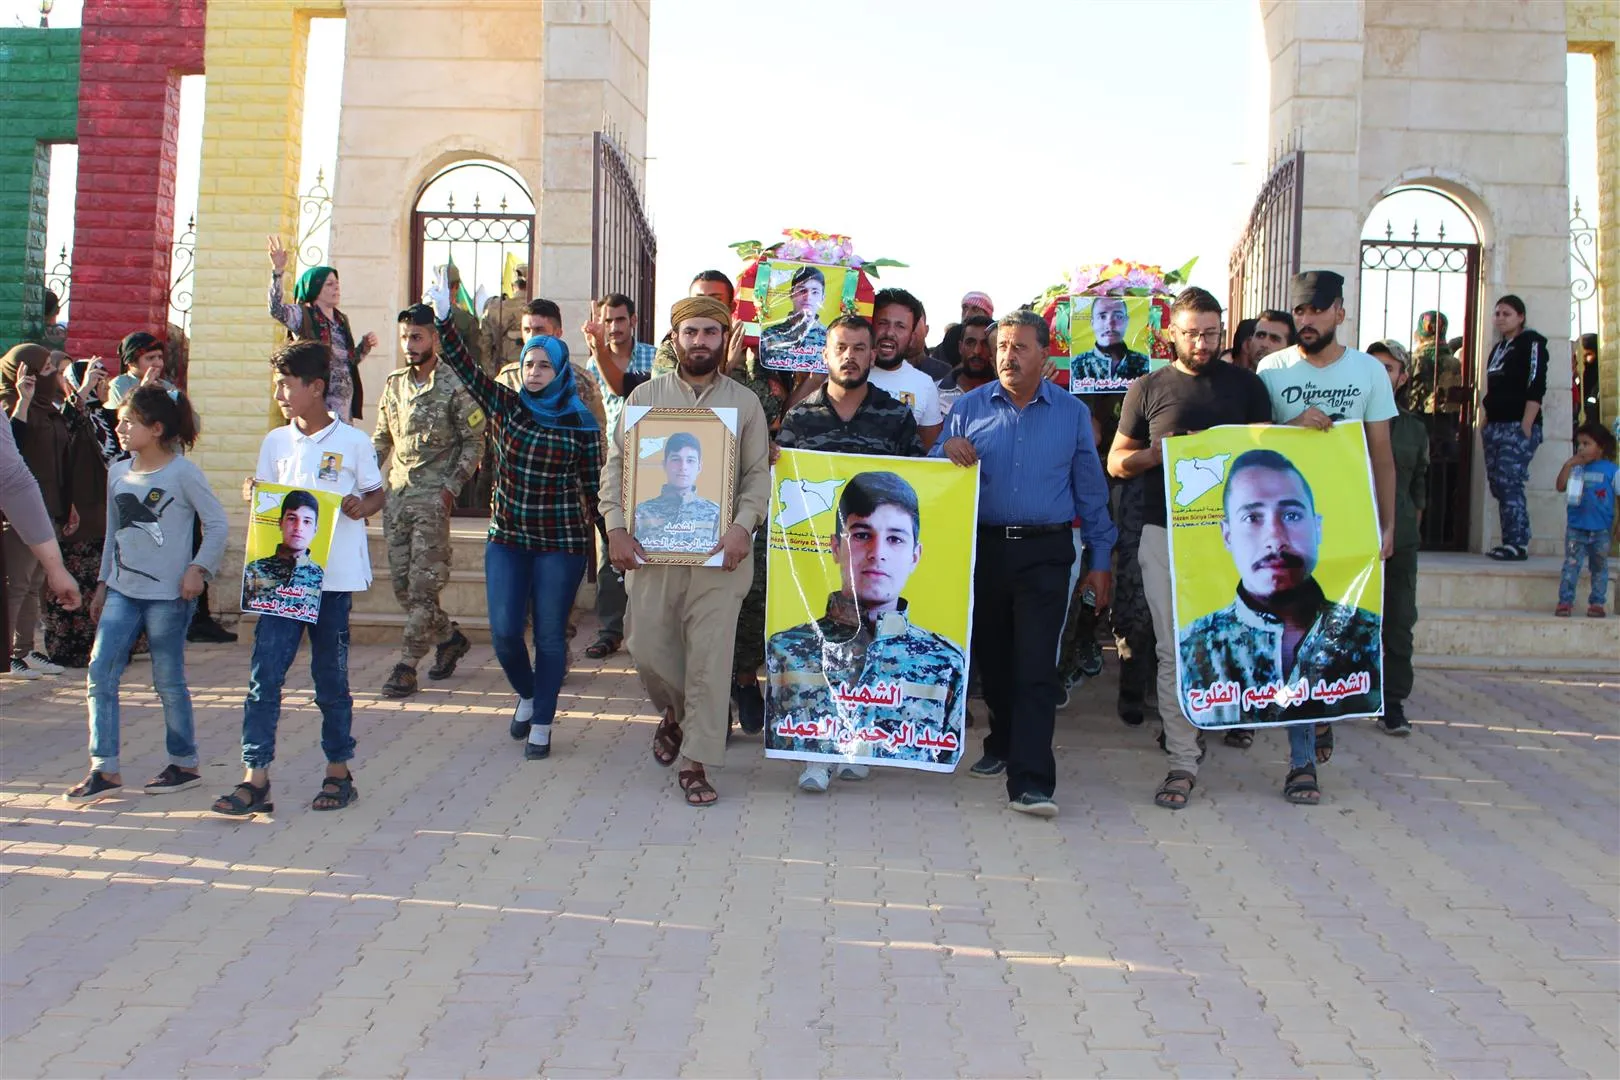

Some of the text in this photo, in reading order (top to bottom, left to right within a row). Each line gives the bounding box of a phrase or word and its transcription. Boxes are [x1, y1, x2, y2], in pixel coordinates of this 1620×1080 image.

[1305, 381, 1317, 389] the
[1281, 384, 1361, 405] Dynamic
[1328, 398, 1354, 408] Way
[664, 520, 695, 534] الشهيد
[642, 537, 668, 548] الحمد
[669, 537, 700, 550] الرحمن
[277, 585, 304, 597] الشهيد
[252, 599, 278, 610] الحمد
[279, 603, 307, 616] الرحمن
[1313, 674, 1369, 701] الشهيد
[833, 681, 901, 708] الشهيد
[1189, 683, 1239, 711] الفلوح
[778, 717, 837, 738] الحمد
[916, 728, 958, 754] عبد
